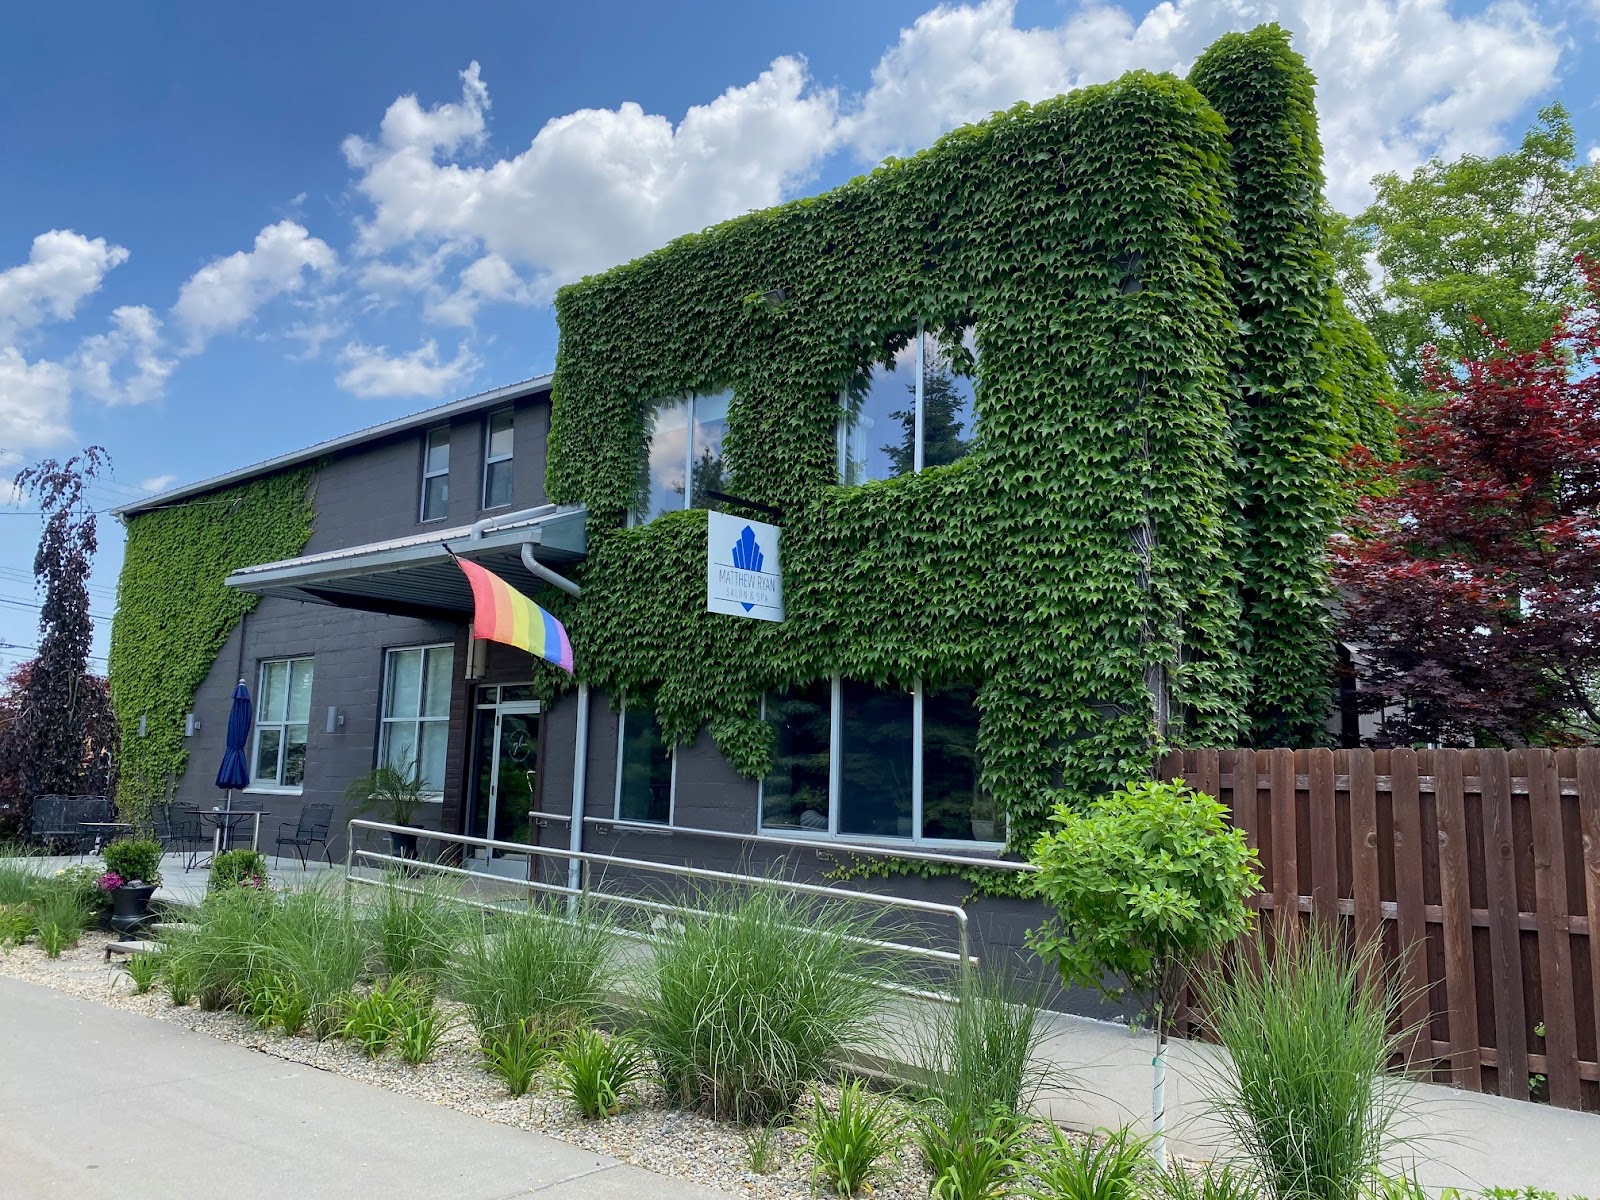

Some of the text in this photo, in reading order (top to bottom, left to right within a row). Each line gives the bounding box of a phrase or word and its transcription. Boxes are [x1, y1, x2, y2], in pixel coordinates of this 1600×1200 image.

[719, 569, 775, 592] MATTHEW RYAN
[726, 587, 768, 602] SALON & SPA
